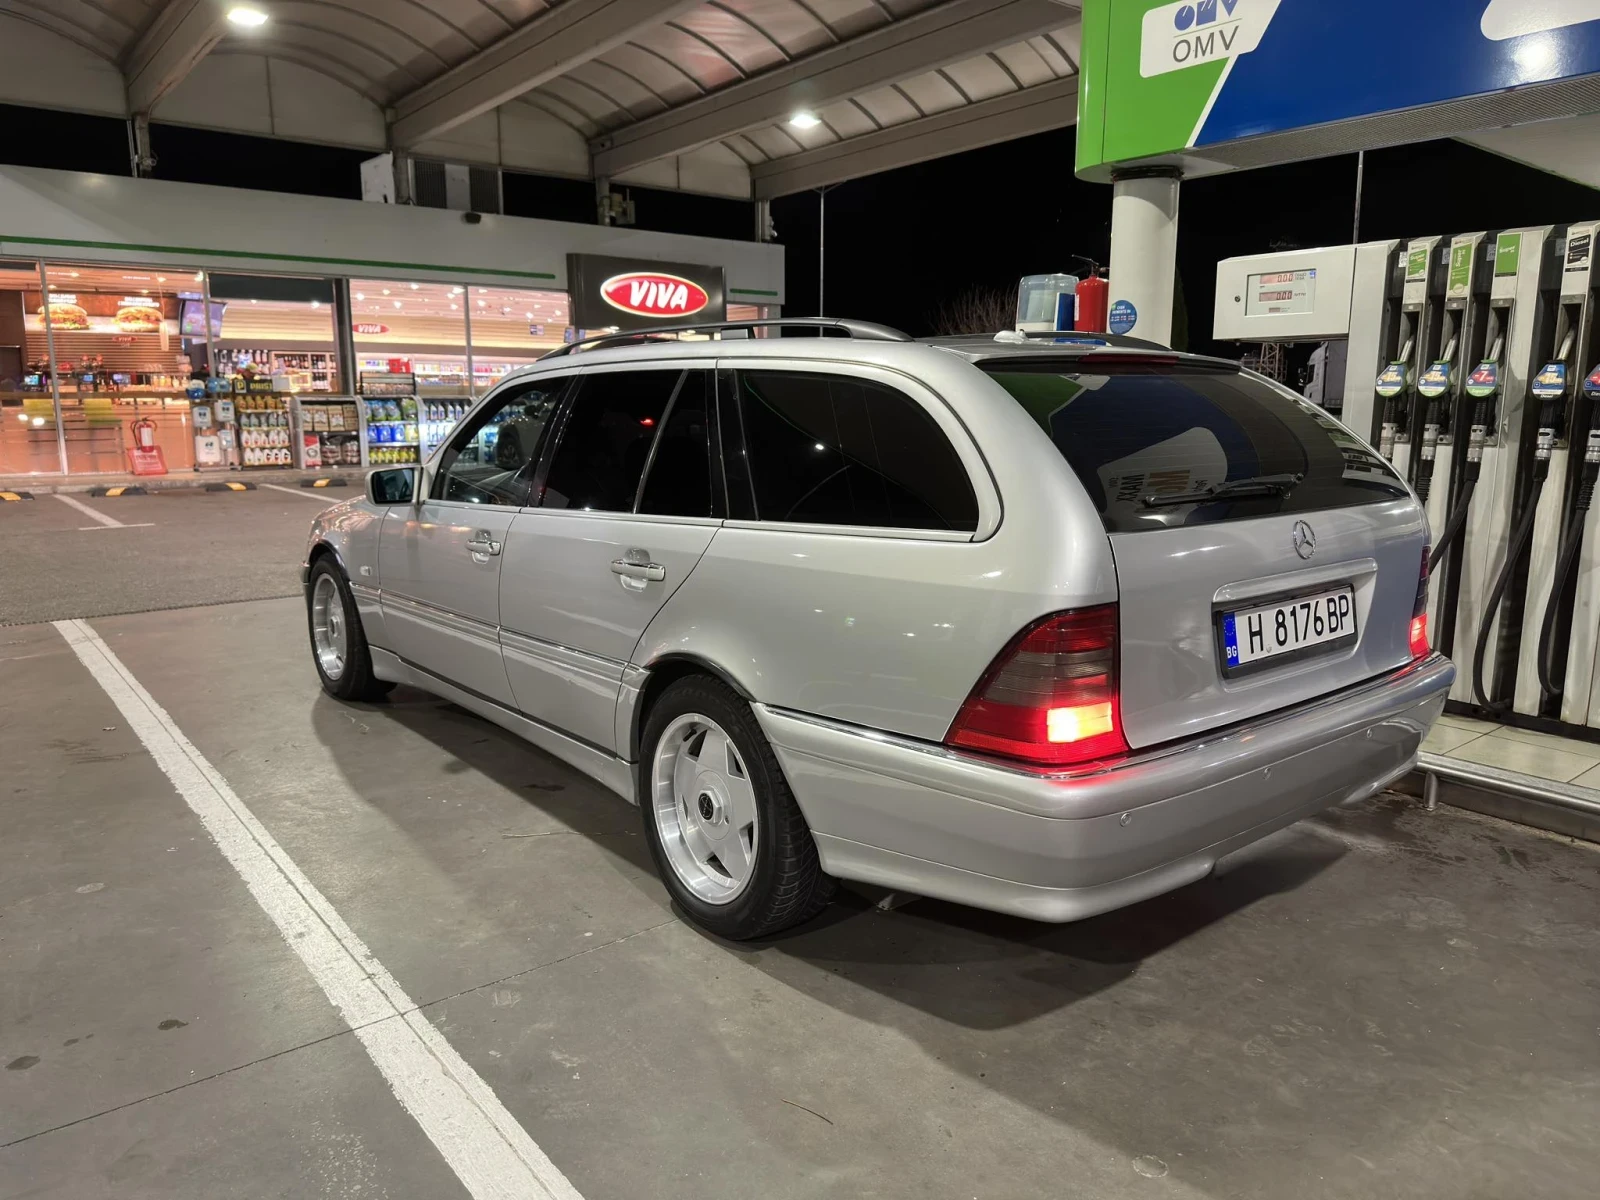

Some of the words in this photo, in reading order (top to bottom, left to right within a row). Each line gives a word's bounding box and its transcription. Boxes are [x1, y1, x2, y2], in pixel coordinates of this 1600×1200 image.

[1173, 25, 1239, 63] OMV
[1570, 237, 1589, 247] Diesel
[630, 280, 689, 310] VIVA
[358, 324, 381, 333] VIVA
[1474, 370, 1489, 381] -7
[1247, 613, 1264, 655] H
[1274, 599, 1325, 648] 8176
[1326, 594, 1349, 633] BP
[1226, 644, 1238, 660] BG
